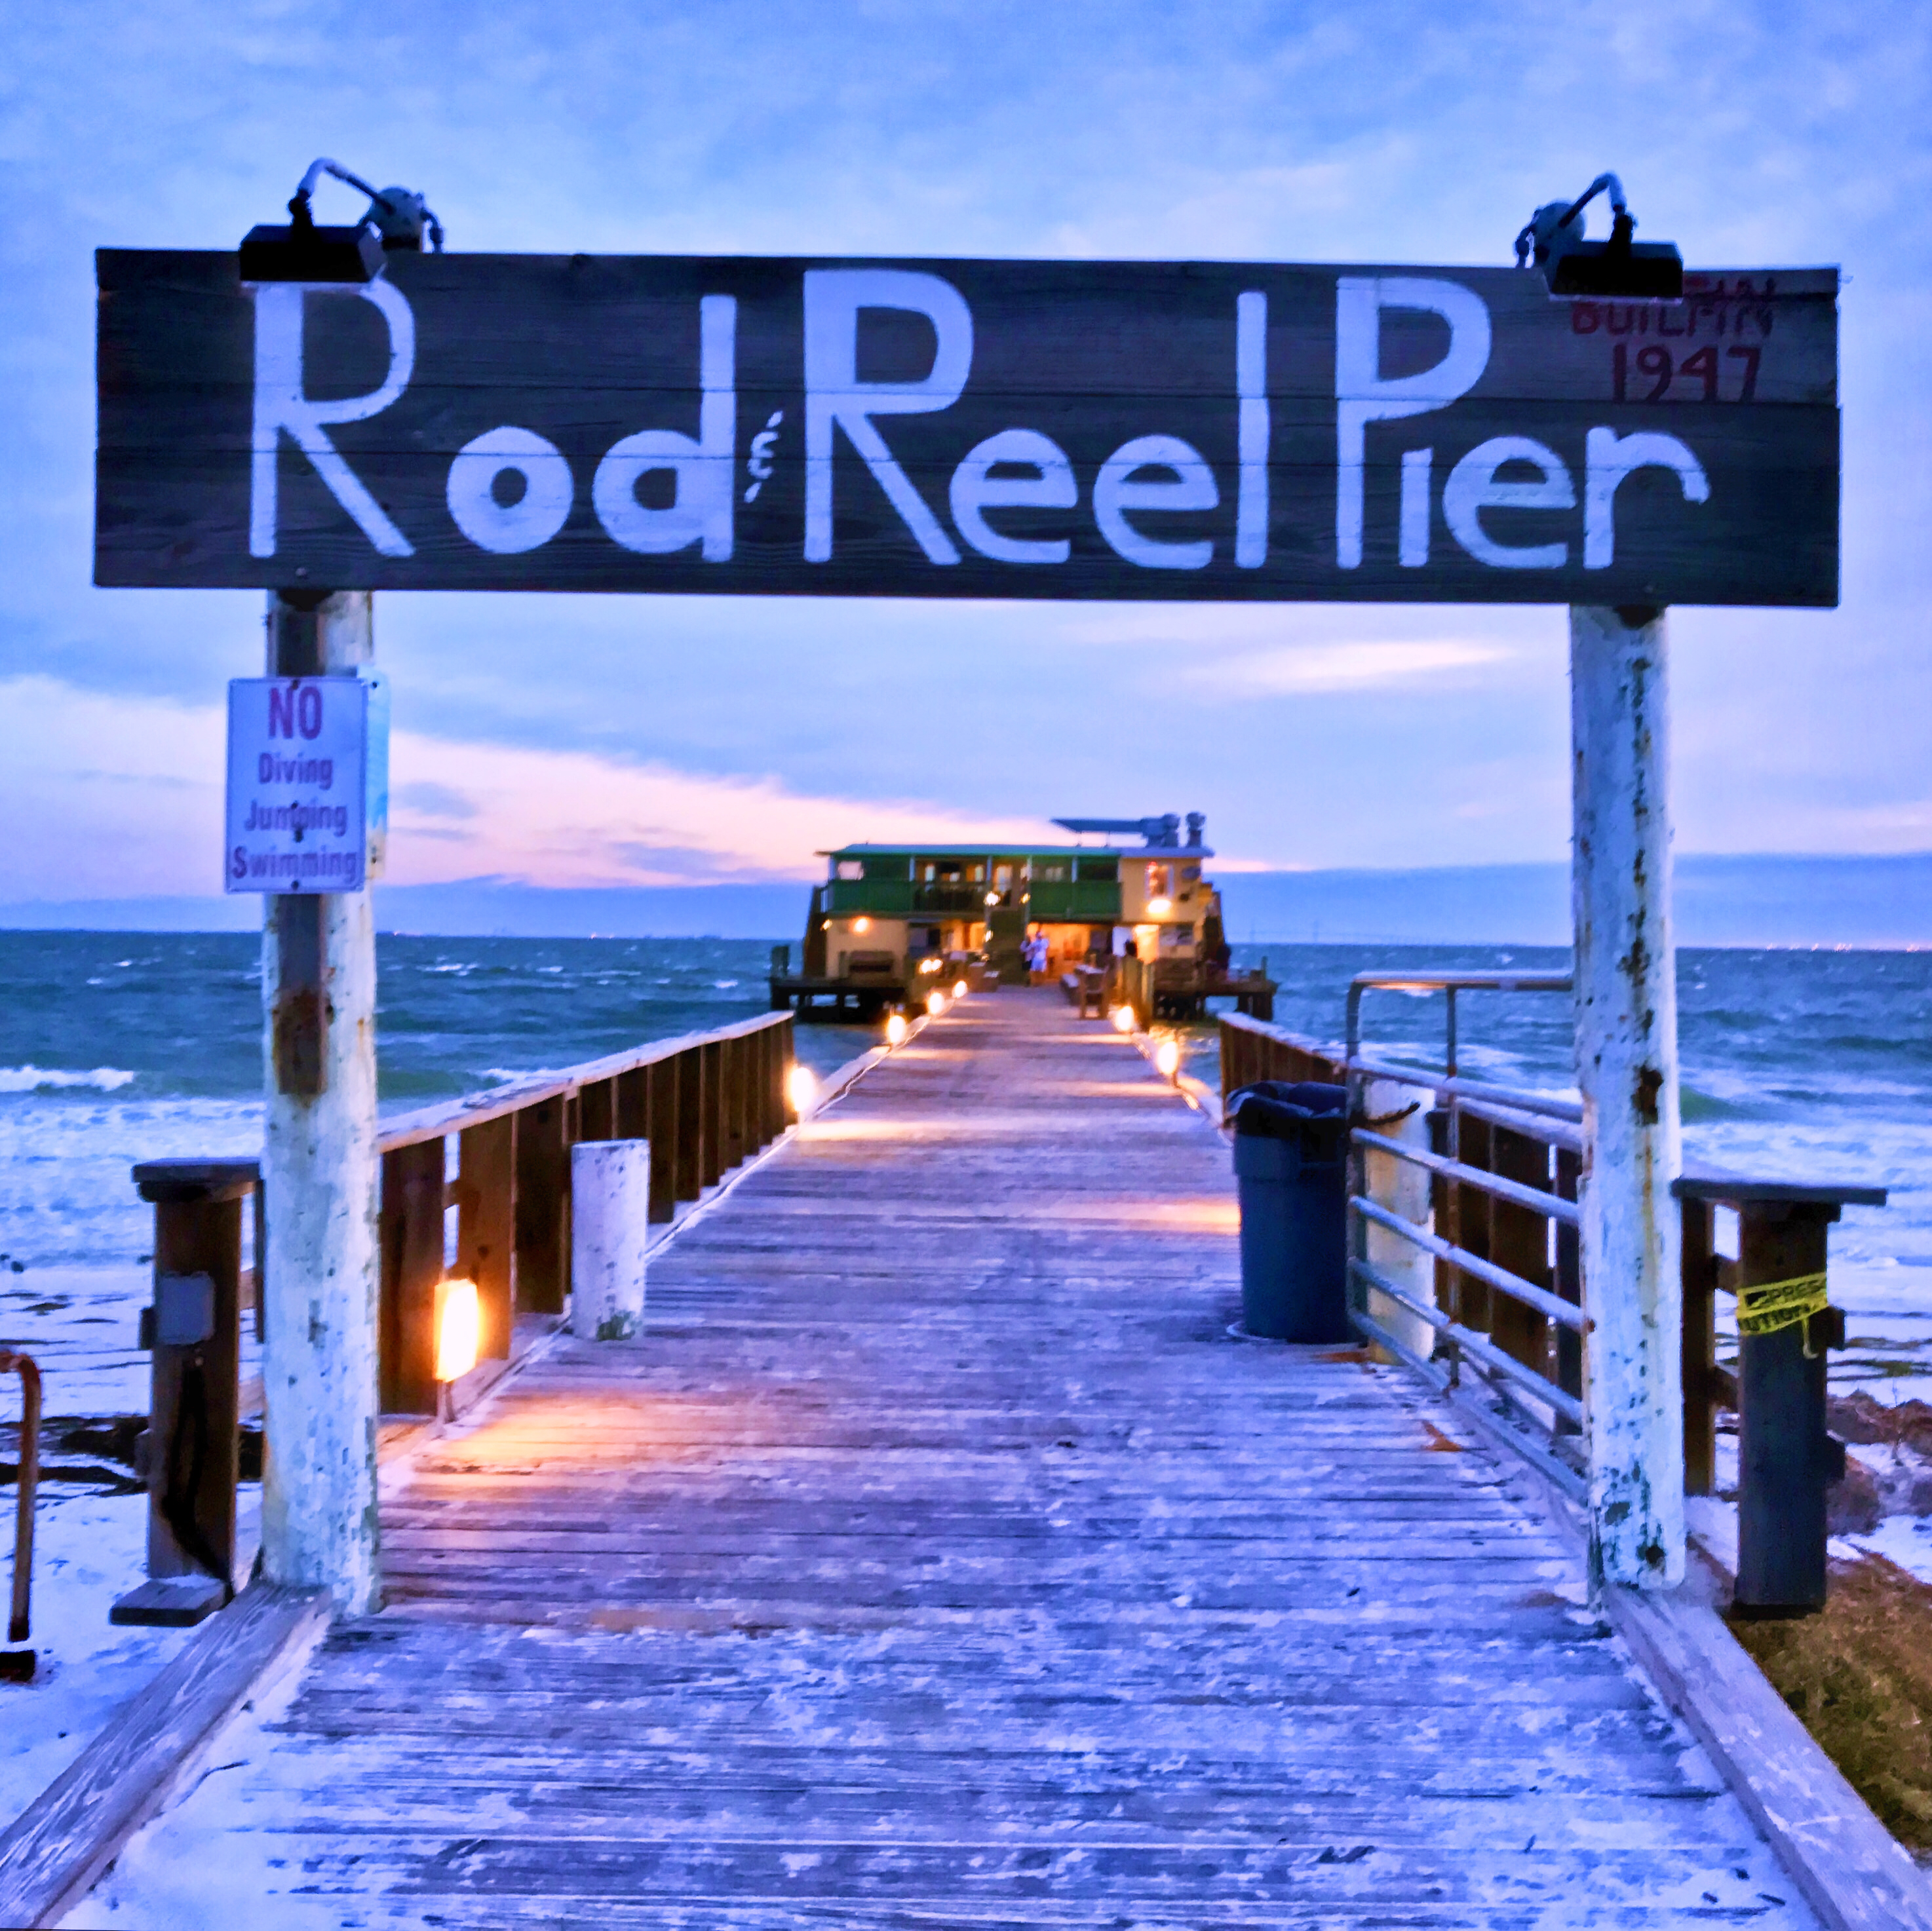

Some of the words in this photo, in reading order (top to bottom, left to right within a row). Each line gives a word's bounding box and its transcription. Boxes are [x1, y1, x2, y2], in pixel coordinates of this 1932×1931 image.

[1613, 343, 1762, 404] 1947
[249, 278, 737, 562] Rod
[803, 269, 1269, 569] Reel
[1335, 277, 1712, 569] Pier
[268, 686, 323, 740] NO
[259, 752, 333, 790] Diving
[244, 797, 347, 837] Jumping
[232, 845, 357, 883] Swimming
